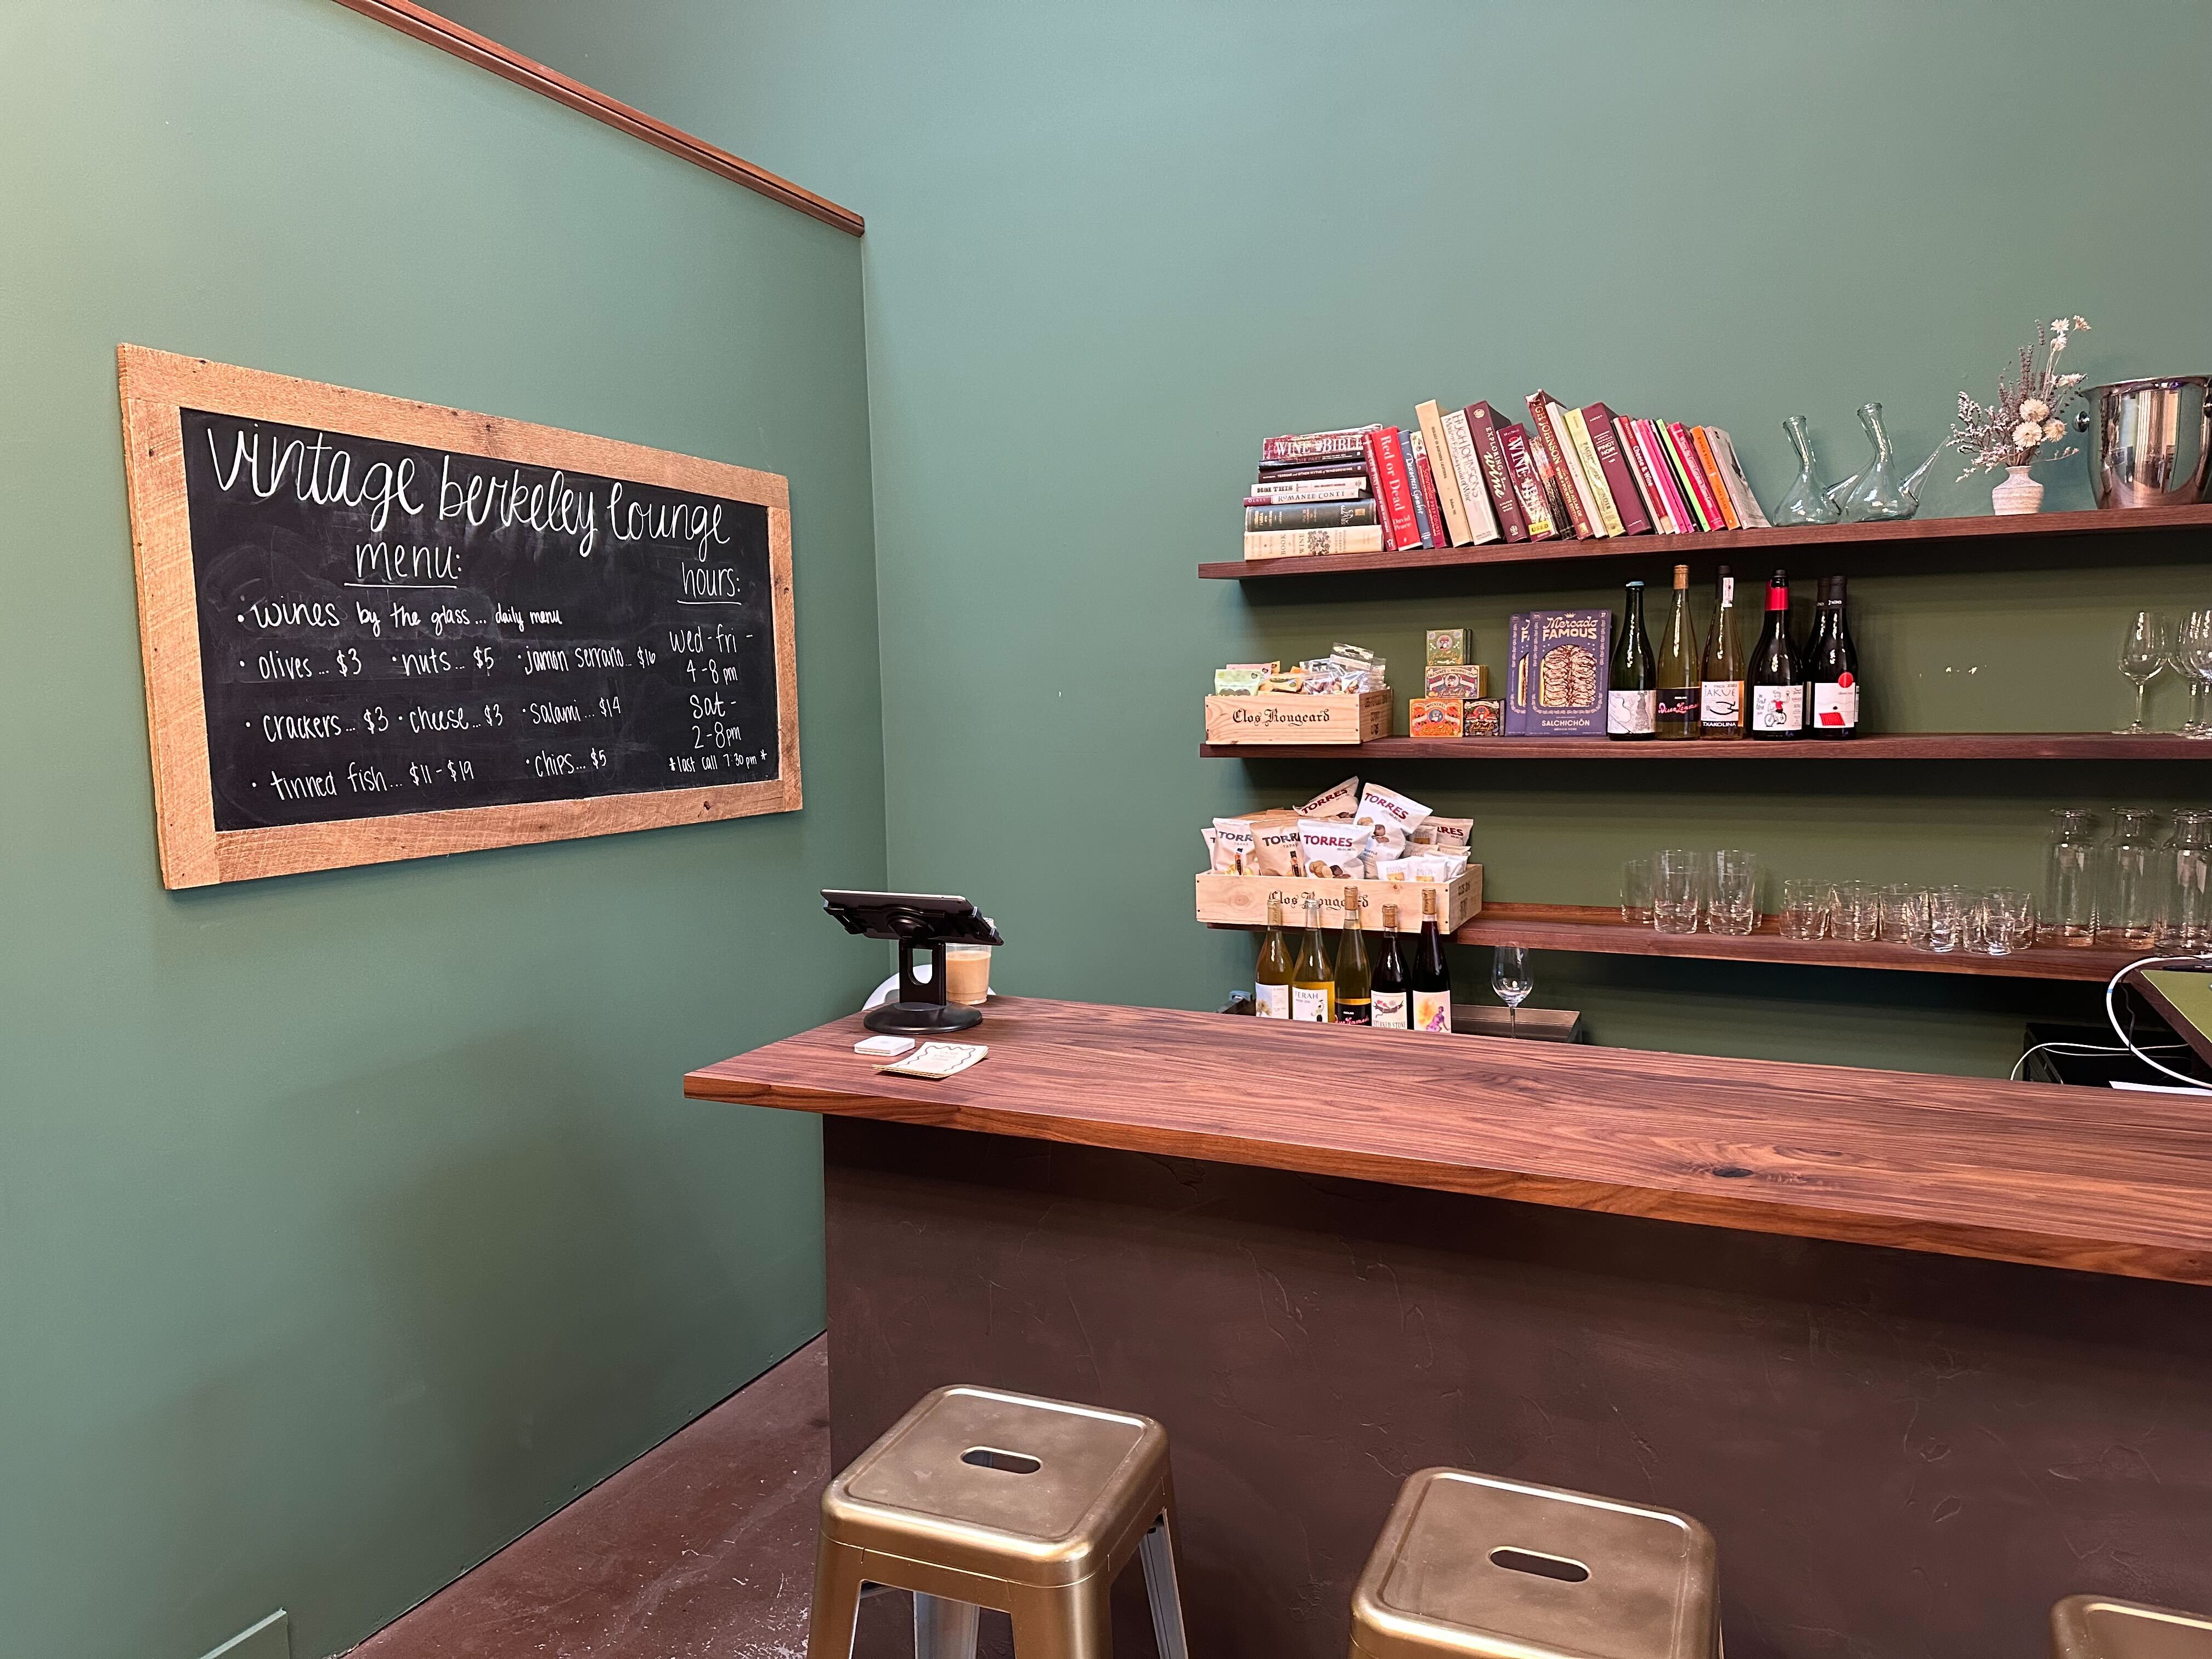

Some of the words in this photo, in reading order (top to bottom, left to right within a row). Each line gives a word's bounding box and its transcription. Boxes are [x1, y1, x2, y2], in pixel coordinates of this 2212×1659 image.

[1451, 414, 1469, 444] HUGH
[1275, 441, 1310, 456] WINE
[1322, 437, 1363, 452] BIBLE
[1380, 435, 1396, 460] Red
[1486, 426, 1503, 471] EXPLORING
[1539, 421, 1562, 465] JOHNSON
[1597, 441, 1615, 452] PINOT
[1601, 446, 1616, 456] NOIR
[1508, 436, 1531, 478] WINE
[1632, 445, 1645, 466] Cheese
[1643, 471, 1654, 487] Wine
[1386, 465, 1396, 477] or
[1482, 450, 1505, 500] wine
[1389, 479, 1406, 511] Dead
[1421, 469, 1435, 500] Sommelier
[1432, 515, 1441, 535] COURSE
[1462, 485, 1472, 503] Wine
[1571, 494, 1579, 510] ATLAS
[1601, 493, 1611, 510] NOIR
[439, 455, 598, 557] berkeley
[607, 482, 730, 562] lounge
[1531, 523, 1549, 532] USED
[356, 541, 462, 581] menu:
[681, 562, 741, 598] hours:
[250, 596, 340, 629] wines
[357, 602, 381, 637] by
[390, 602, 422, 628] the
[495, 603, 524, 632] daily
[531, 608, 562, 625] menu
[1542, 616, 1599, 629] Mercado
[1542, 628, 1598, 642] FAMOUS
[336, 648, 362, 677] $3
[473, 646, 494, 669] $5
[723, 665, 738, 686] pm
[484, 704, 504, 726] $3
[599, 696, 622, 718] $14
[1232, 708, 1262, 726] Clos
[1263, 708, 1330, 726] Rougeard
[363, 706, 389, 734] $3
[1542, 718, 1590, 727] SALCHICHÓN
[590, 747, 607, 769] $5
[702, 754, 717, 771] call
[270, 770, 337, 800] tinned
[1302, 788, 1348, 814] TORRES
[1364, 793, 1409, 820] TORRES
[1219, 831, 1253, 842] TORR
[1262, 832, 1301, 847] TORR
[1304, 834, 1353, 847] TORRES
[1437, 826, 1464, 837] RES
[1295, 991, 1318, 1000] TERAH
